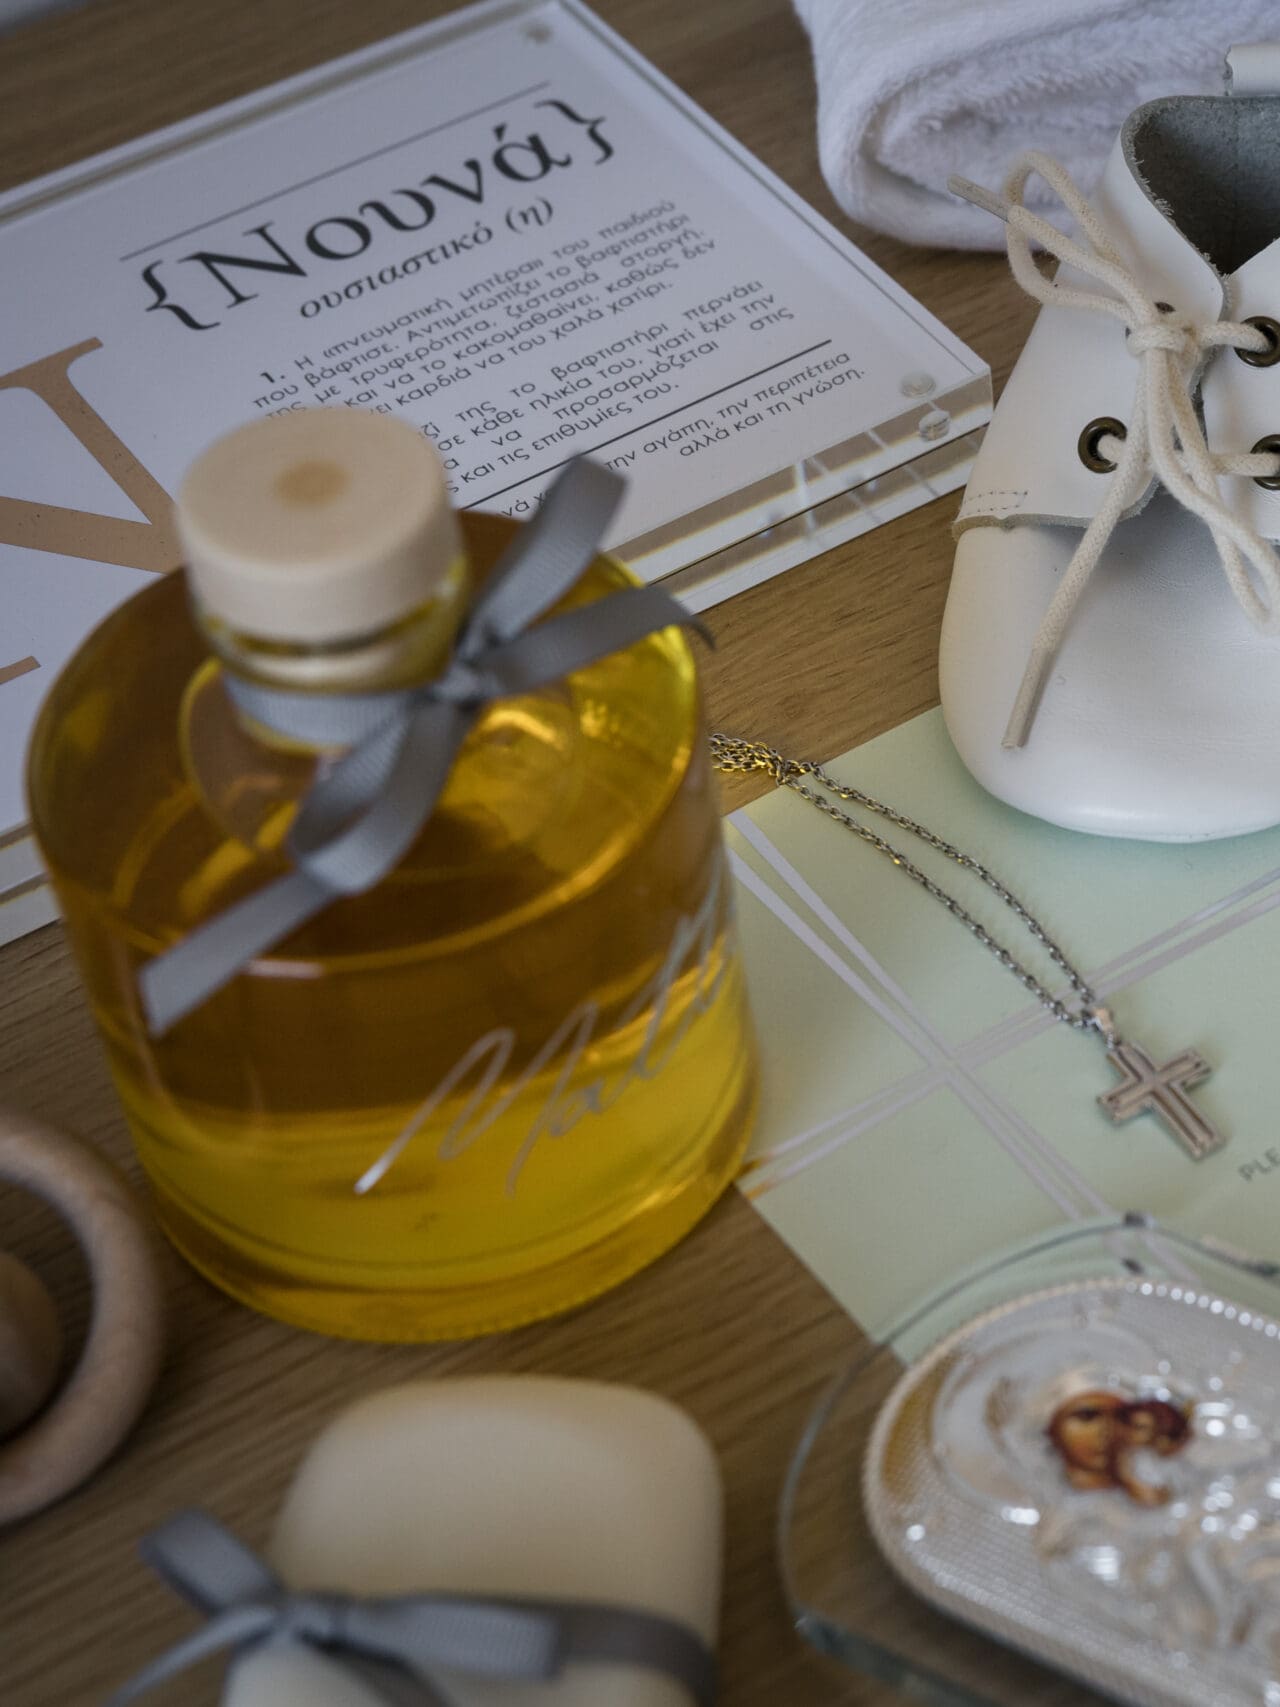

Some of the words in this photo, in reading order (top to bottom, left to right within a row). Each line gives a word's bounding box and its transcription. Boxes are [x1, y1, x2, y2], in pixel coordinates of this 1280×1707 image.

[252, 384, 299, 408] που
[304, 343, 399, 388] βάφτισε.
[407, 278, 541, 342] Αντιμετωπίζει
[546, 265, 571, 281] το
[575, 213, 690, 270] βαφτιστήρι
[260, 371, 285, 385] 1.
[294, 356, 314, 370] Η
[552, 238, 590, 260] του
[598, 200, 675, 240] παιδιού
[300, 221, 493, 319] ουσιαστικό
[505, 196, 553, 235] (η)
[343, 389, 379, 408] και
[383, 372, 415, 390] να
[421, 359, 446, 376] το
[605, 256, 679, 293] καθώς
[681, 238, 716, 260] δεν
[315, 385, 341, 403] με
[504, 271, 600, 319] ζεστασιά
[395, 366, 472, 407] καρδιά
[474, 352, 505, 370] να
[508, 335, 546, 357] του
[549, 308, 604, 340] χαλά
[437, 435, 465, 452] σε
[470, 408, 524, 437] κάθε
[529, 376, 593, 412] ηλικία
[648, 330, 696, 360] γιατί
[700, 313, 737, 334] έχει
[740, 294, 776, 315] την
[455, 401, 497, 423] της
[509, 382, 536, 399] το
[550, 322, 669, 382] βαφτιστήρι
[682, 279, 764, 322] περνάει
[491, 429, 522, 448] να
[552, 340, 719, 421] προσαρμόζεται
[749, 307, 795, 332] στις
[460, 462, 496, 484] και
[498, 448, 530, 467] τις
[531, 401, 632, 452] επιθυμίες
[631, 383, 679, 406] του.
[604, 450, 636, 472] την
[642, 418, 714, 454] αγάπη,
[716, 398, 749, 420] την
[753, 352, 851, 403] περιπέτεια
[679, 428, 730, 458] αλλά
[734, 412, 764, 432] και
[766, 401, 791, 418] τη
[792, 367, 865, 406] γνώση.
